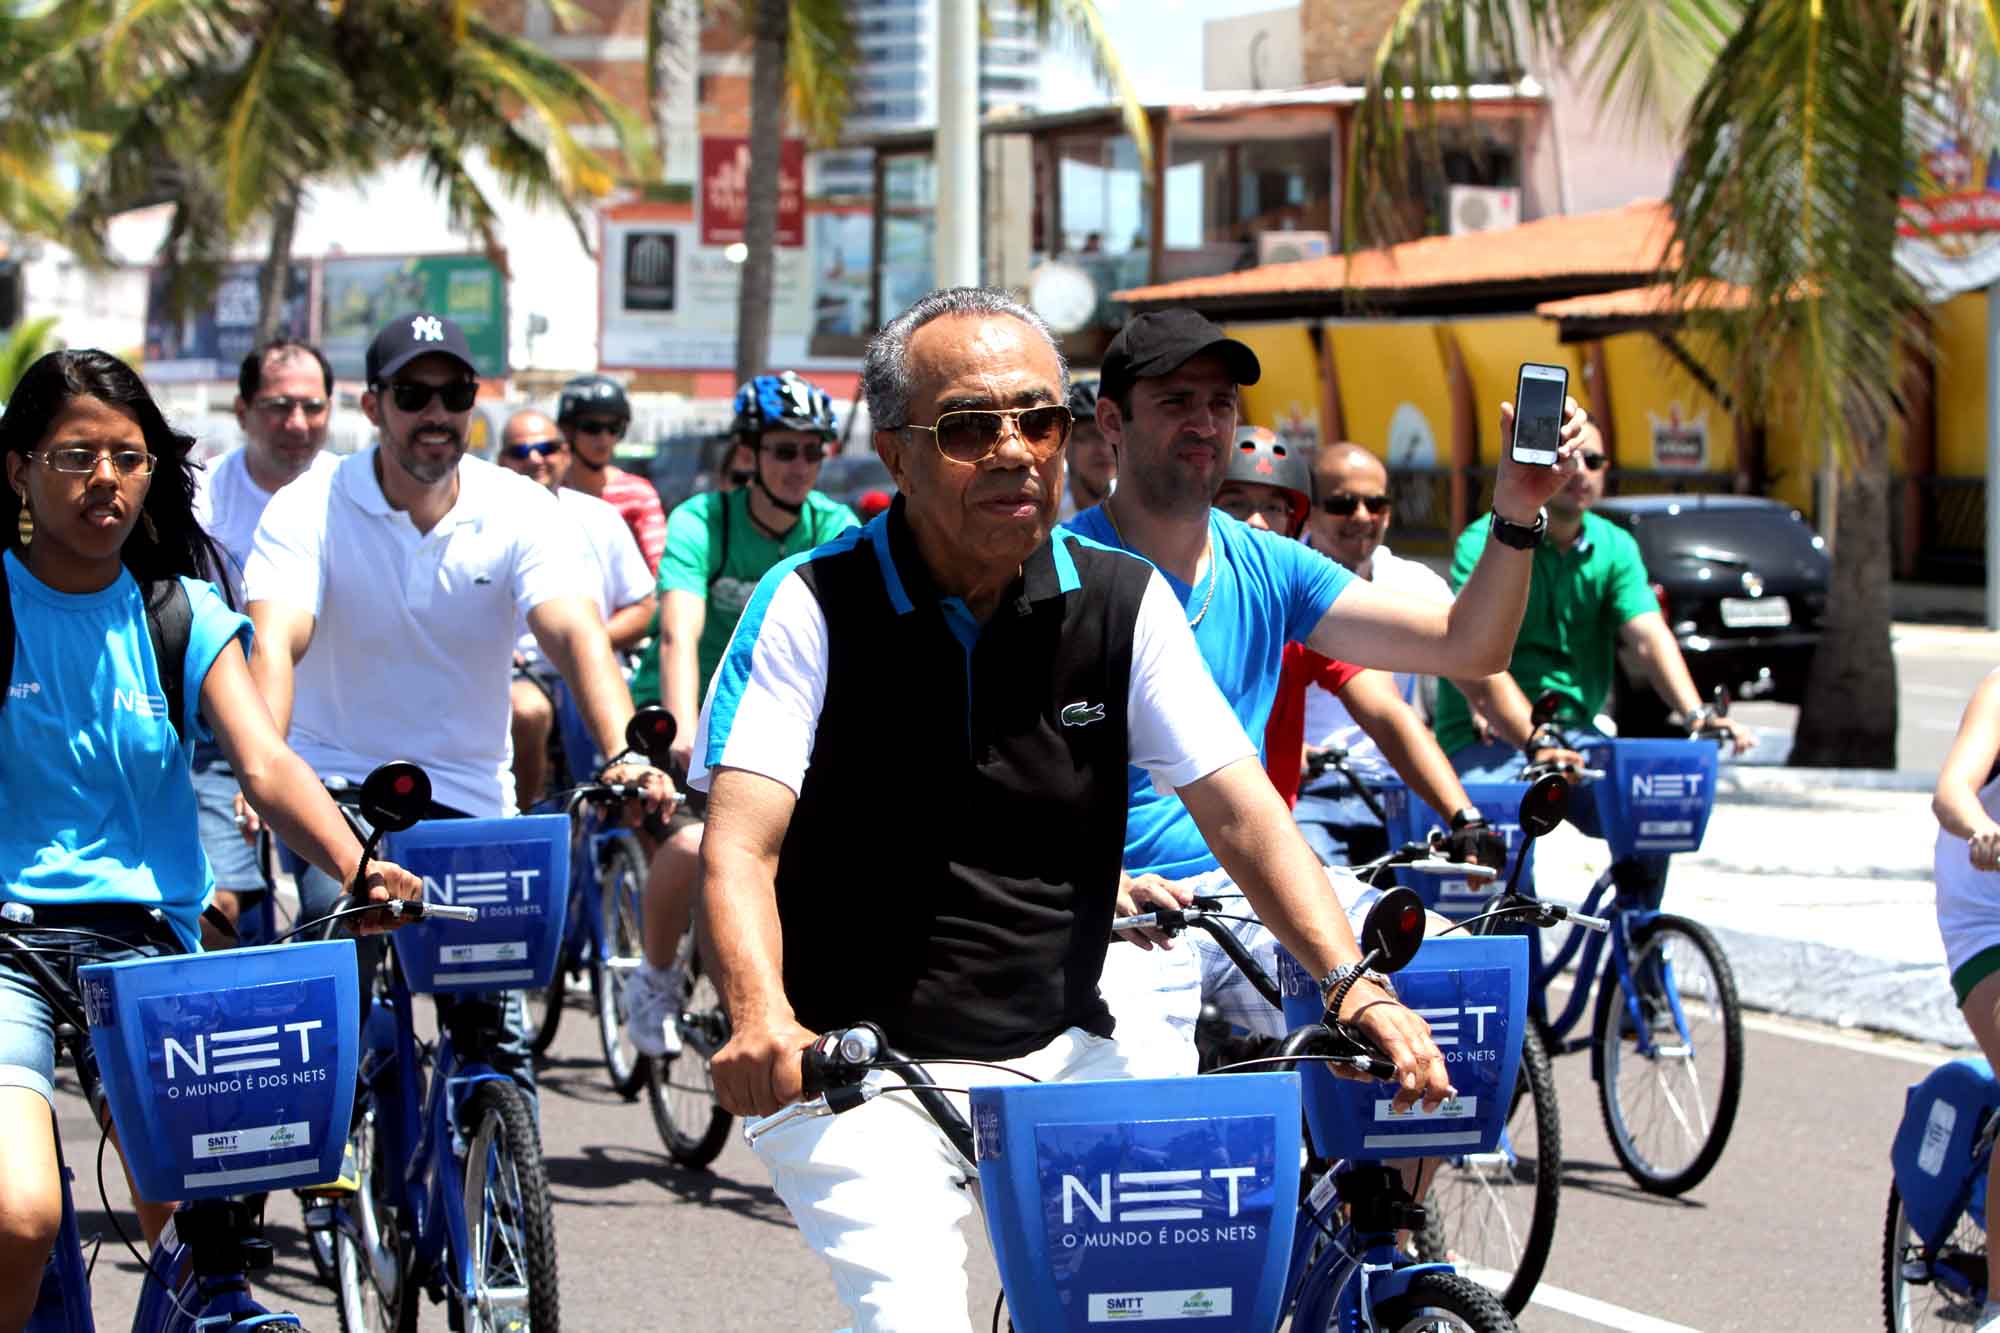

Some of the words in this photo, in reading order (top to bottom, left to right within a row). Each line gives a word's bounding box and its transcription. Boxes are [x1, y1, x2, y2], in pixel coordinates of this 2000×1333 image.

[1632, 774, 1704, 797] NET
[423, 870, 540, 905] NET
[490, 906, 512, 917] DOS
[515, 904, 541, 915] NETS
[1411, 1005, 1497, 1044] ET
[163, 1019, 322, 1079] NET
[1446, 1051, 1463, 1063] OS
[1467, 1049, 1496, 1062] NETS
[168, 1086, 179, 1098] O
[185, 1079, 241, 1098] MUNDO
[246, 1074, 254, 1090] É
[259, 1075, 288, 1088] DOS
[293, 1068, 326, 1084] NETS
[208, 1135, 238, 1147] SMTT
[1062, 1167, 1256, 1224] NET
[1062, 1234, 1076, 1248] O
[1084, 1231, 1152, 1247] MUNDO
[1159, 1226, 1167, 1244] É
[1174, 1229, 1210, 1244] DOS
[1216, 1226, 1257, 1241] NETS
[1107, 1298, 1143, 1310] SMTT
